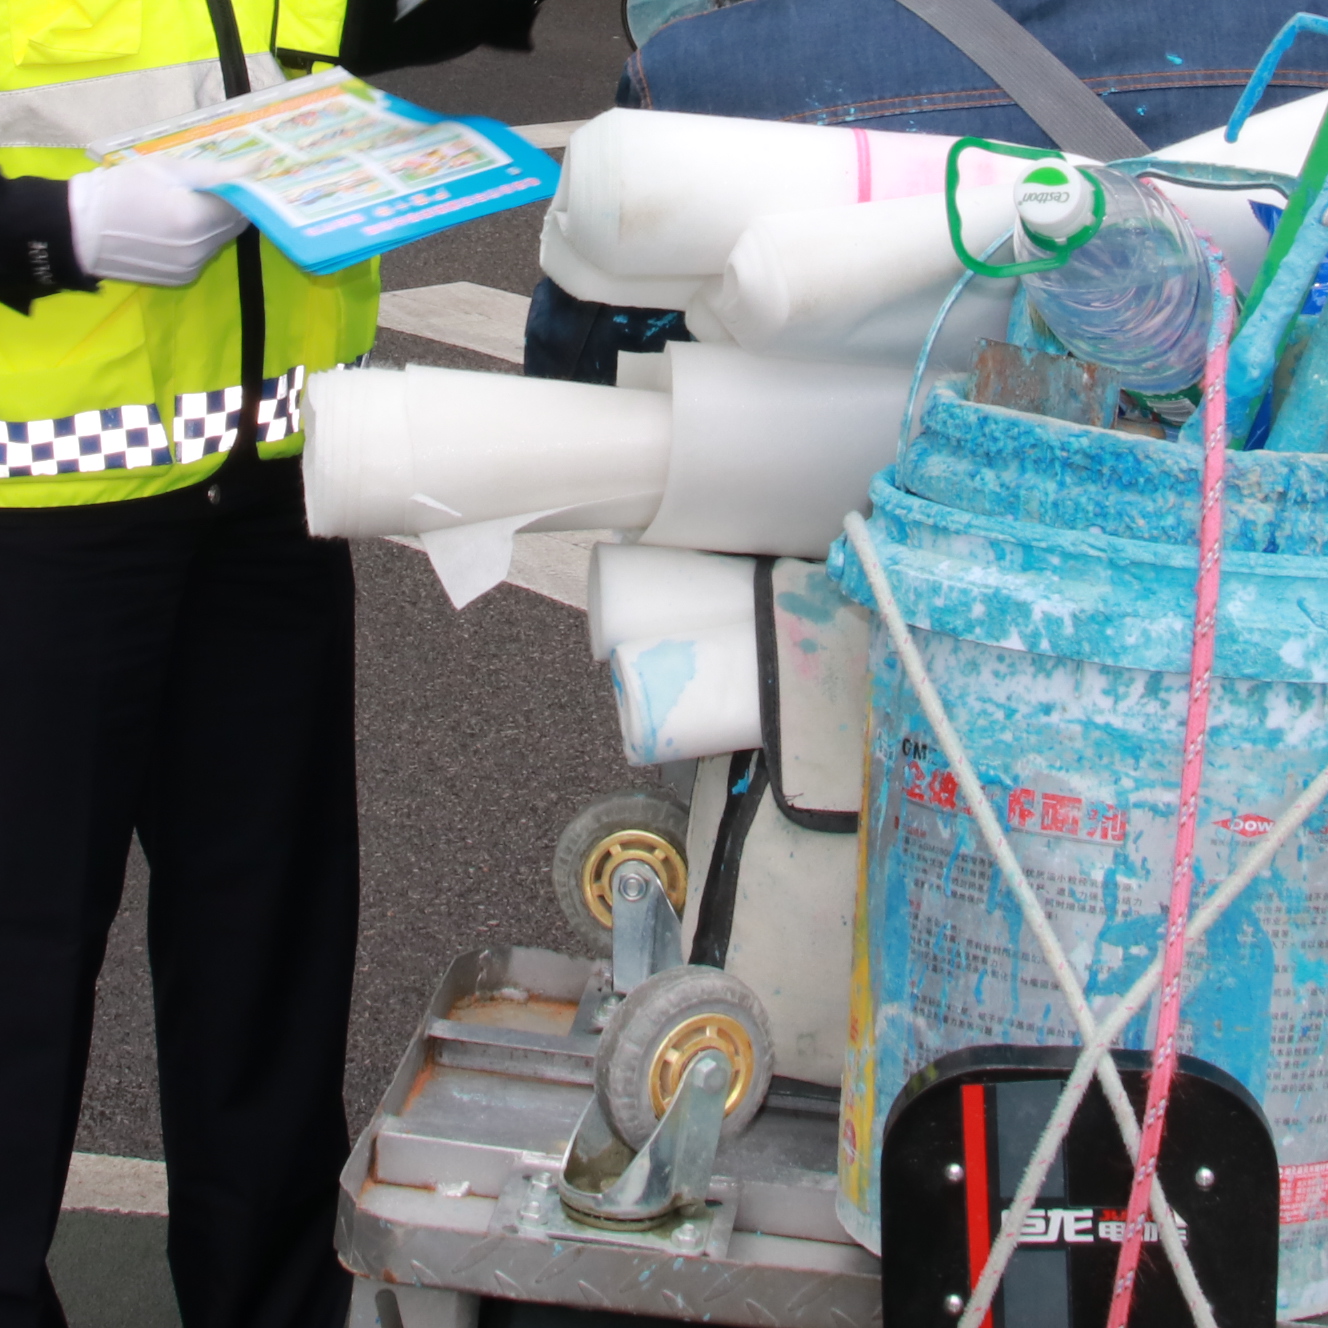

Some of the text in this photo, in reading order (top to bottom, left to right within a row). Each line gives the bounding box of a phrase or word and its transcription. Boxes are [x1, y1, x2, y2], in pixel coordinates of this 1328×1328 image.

[1022, 191, 1071, 205] Cestbon
[1228, 817, 1274, 832] DOW
[1000, 1208, 1095, 1243] 巨龙
